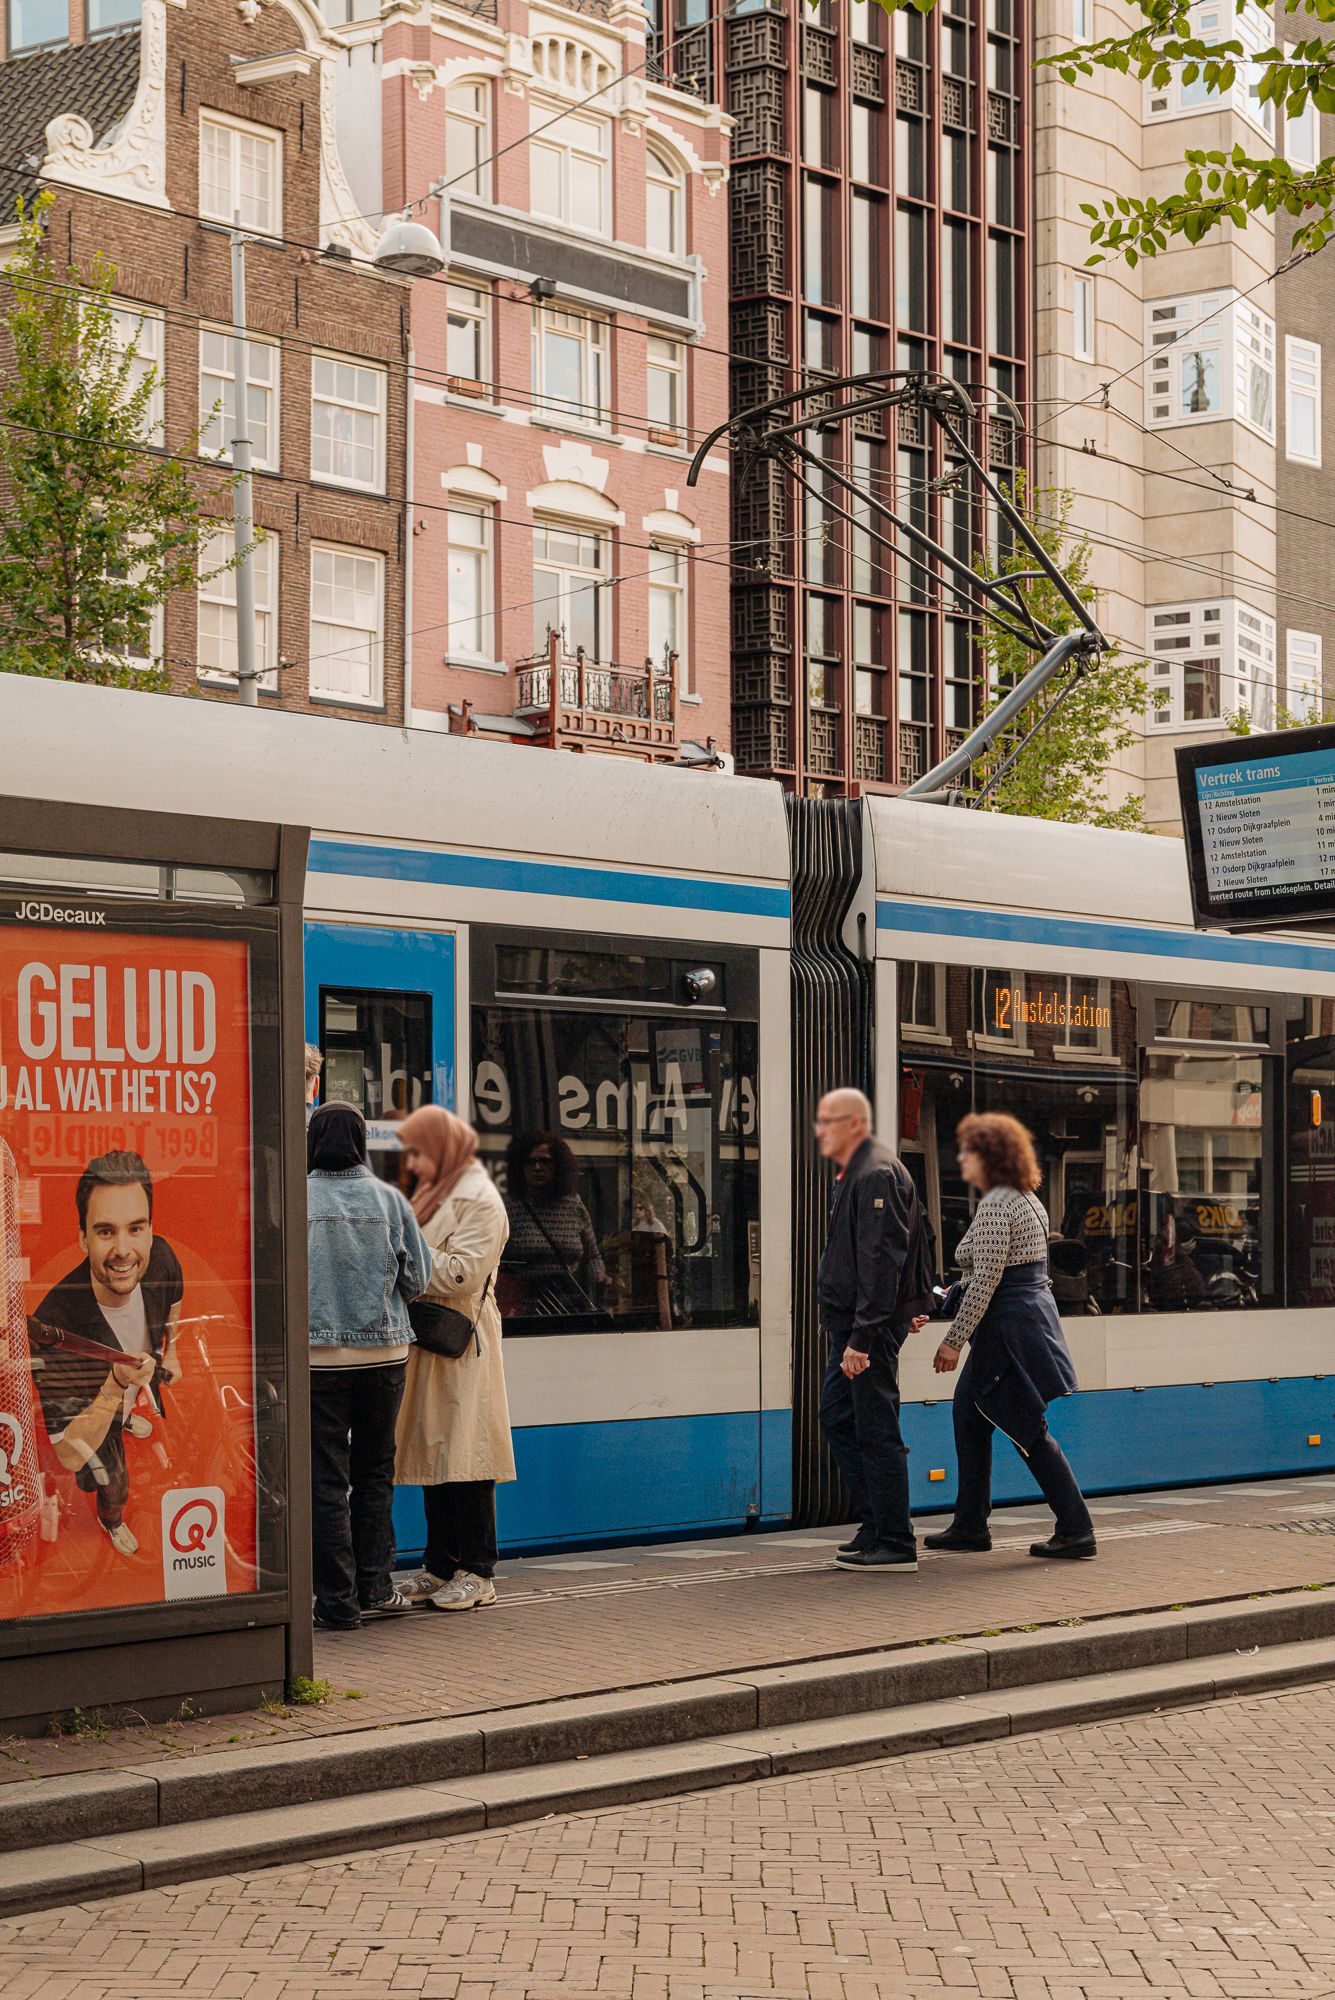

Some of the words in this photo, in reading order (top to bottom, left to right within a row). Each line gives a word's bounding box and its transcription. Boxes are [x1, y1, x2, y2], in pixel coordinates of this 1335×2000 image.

[1199, 768, 1243, 787] Vertrek
[1246, 766, 1281, 780] trams
[1316, 787, 1320, 795] 1
[1204, 802, 1212, 810] 12
[1215, 797, 1261, 808] Amstelstation
[1318, 800, 1321, 808] 1
[1210, 815, 1214, 823] 2
[1216, 812, 1238, 821] Nieuw
[1239, 810, 1261, 819] Sloten
[1318, 814, 1323, 822] 4
[1208, 828, 1215, 836] 17
[1218, 824, 1241, 835] Osdorp
[1243, 818, 1291, 832] Dijkgraafplein
[1316, 828, 1325, 836] 10
[1212, 841, 1217, 849] 2
[1219, 838, 1240, 848] Nieuw
[1242, 836, 1264, 845] Sloten
[1318, 841, 1326, 849] 11
[1211, 854, 1218, 862] 12
[1221, 848, 1267, 861] Amstelstation
[1319, 854, 1327, 862] 12
[1212, 867, 1220, 875] 17
[1222, 863, 1246, 873] Osdorp
[1247, 857, 1295, 872] Dijkgraafplein
[1321, 868, 1329, 876] 17
[1217, 880, 1221, 888] 2
[1223, 877, 1245, 887] Nieuw
[1246, 875, 1268, 884] Sloten
[1234, 890, 1254, 899] route
[1254, 887, 1271, 897] from
[1272, 883, 1313, 895] Leidseplein.
[15, 901, 106, 925] JCDecaux
[17, 961, 217, 1065] GELUID
[1013, 989, 1110, 1028] Amstelstation
[14, 1065, 50, 1111] AL
[54, 1066, 116, 1112] WAT
[121, 1068, 170, 1113] HET
[175, 1070, 217, 1114] IS?
[173, 1554, 216, 1571] MUSIC
[463, 1582, 475, 1592] N
